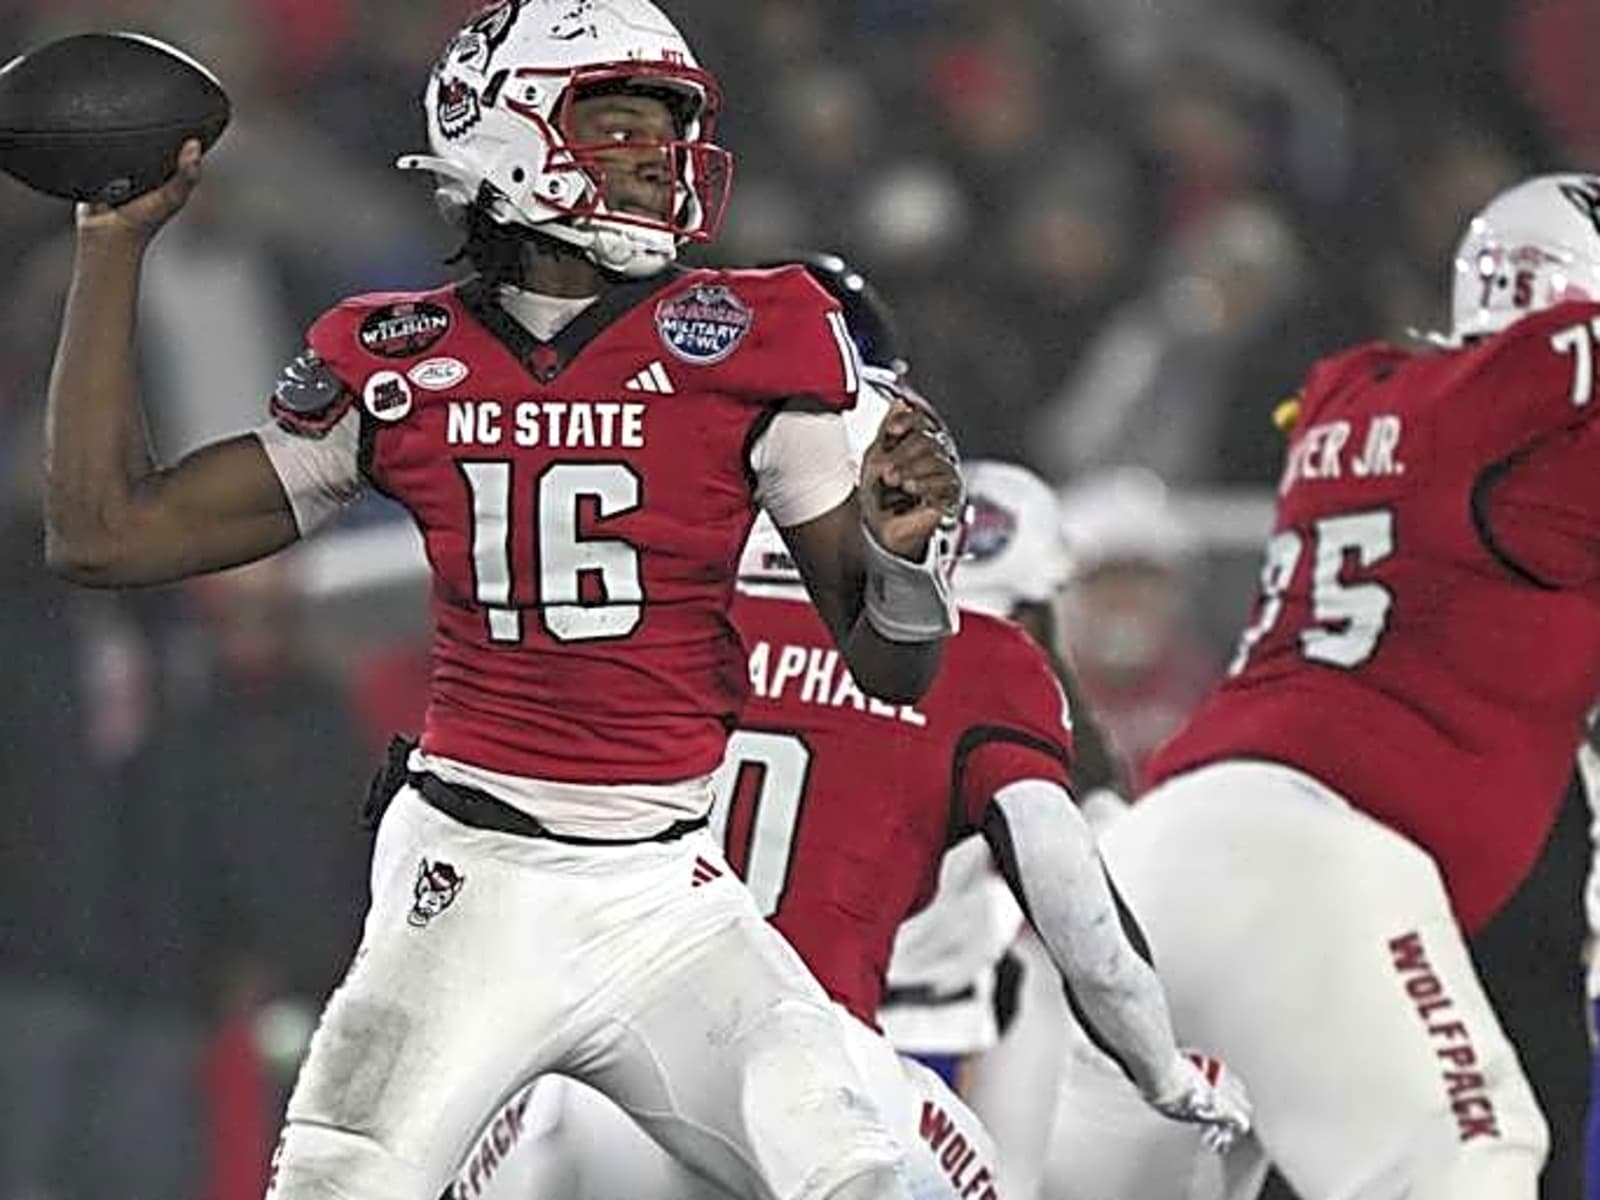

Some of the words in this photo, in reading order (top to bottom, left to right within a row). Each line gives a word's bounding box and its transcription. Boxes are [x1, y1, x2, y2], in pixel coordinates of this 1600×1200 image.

[662, 318, 739, 340] MILITARY
[1551, 317, 1600, 406] 7
[447, 402, 501, 446] NC
[515, 403, 646, 449] STATE
[1351, 415, 1404, 477] JR.
[456, 459, 644, 642] 16
[748, 641, 928, 727] APHA
[1388, 930, 1501, 1142] WOLFPACK
